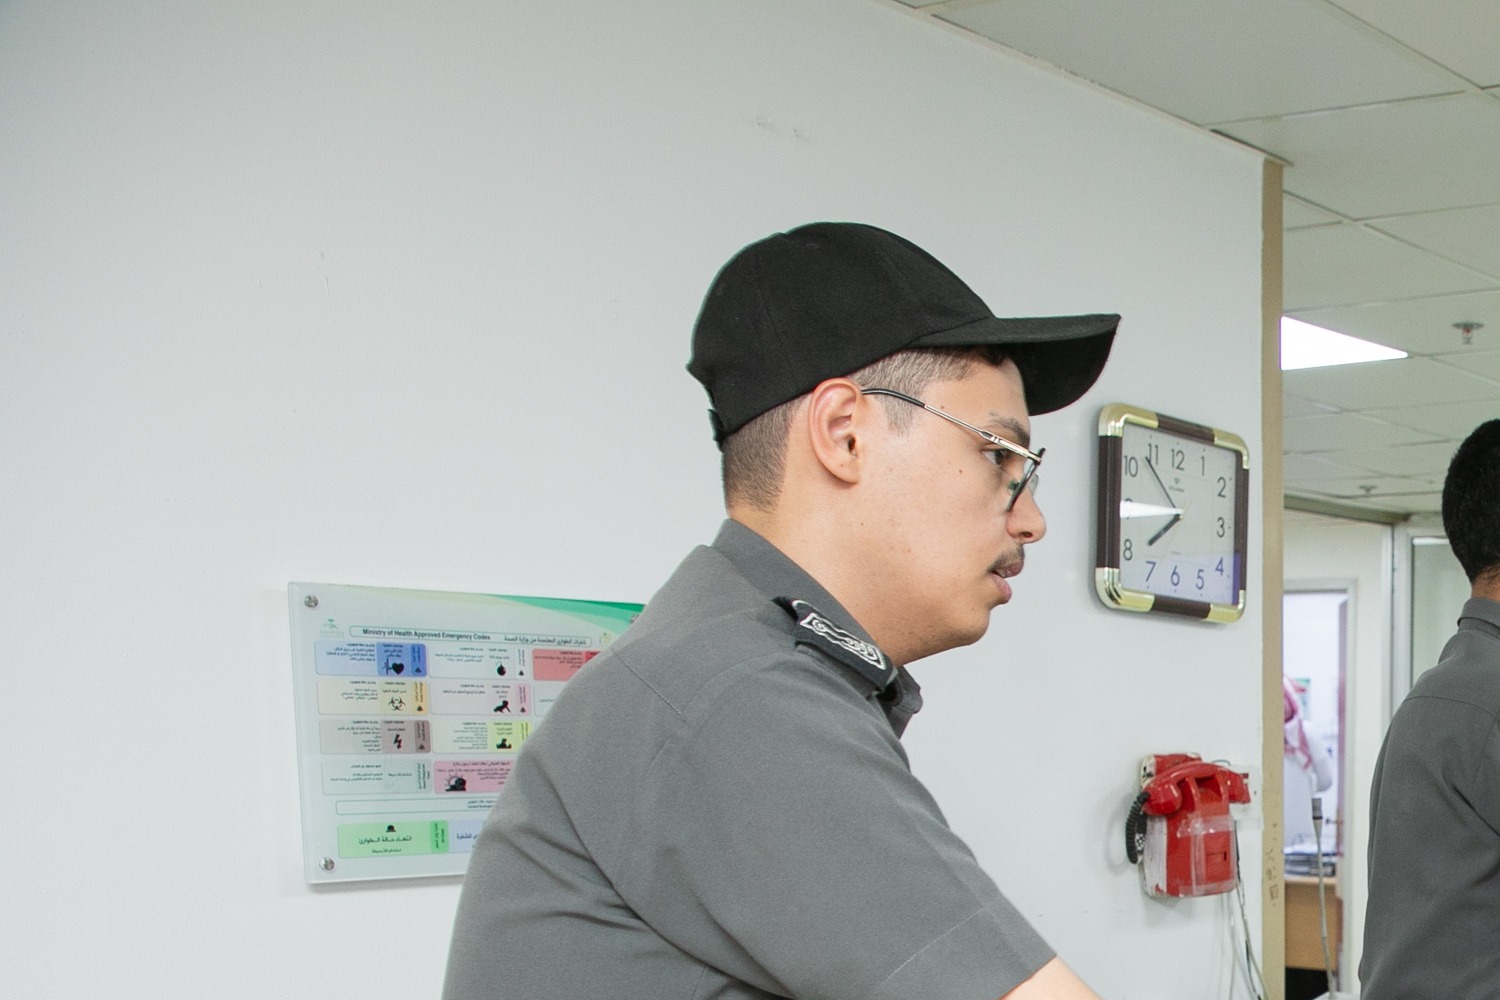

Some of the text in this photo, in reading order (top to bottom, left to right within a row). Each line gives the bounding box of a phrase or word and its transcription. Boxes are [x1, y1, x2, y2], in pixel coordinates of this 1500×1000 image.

[1148, 443, 1159, 465] 11
[1171, 449, 1185, 471] 12
[1123, 455, 1139, 477] 10
[1200, 455, 1205, 476] 1
[1217, 476, 1227, 498] 2
[1216, 516, 1226, 538] 3
[1123, 538, 1133, 561] 8
[1145, 561, 1156, 582] 7
[1170, 565, 1181, 586] 6
[1215, 557, 1224, 576] 4
[1195, 569, 1205, 590] 5
[362, 628, 386, 637] Ministry
[414, 631, 441, 639] Approved
[442, 632, 473, 640] Emergency
